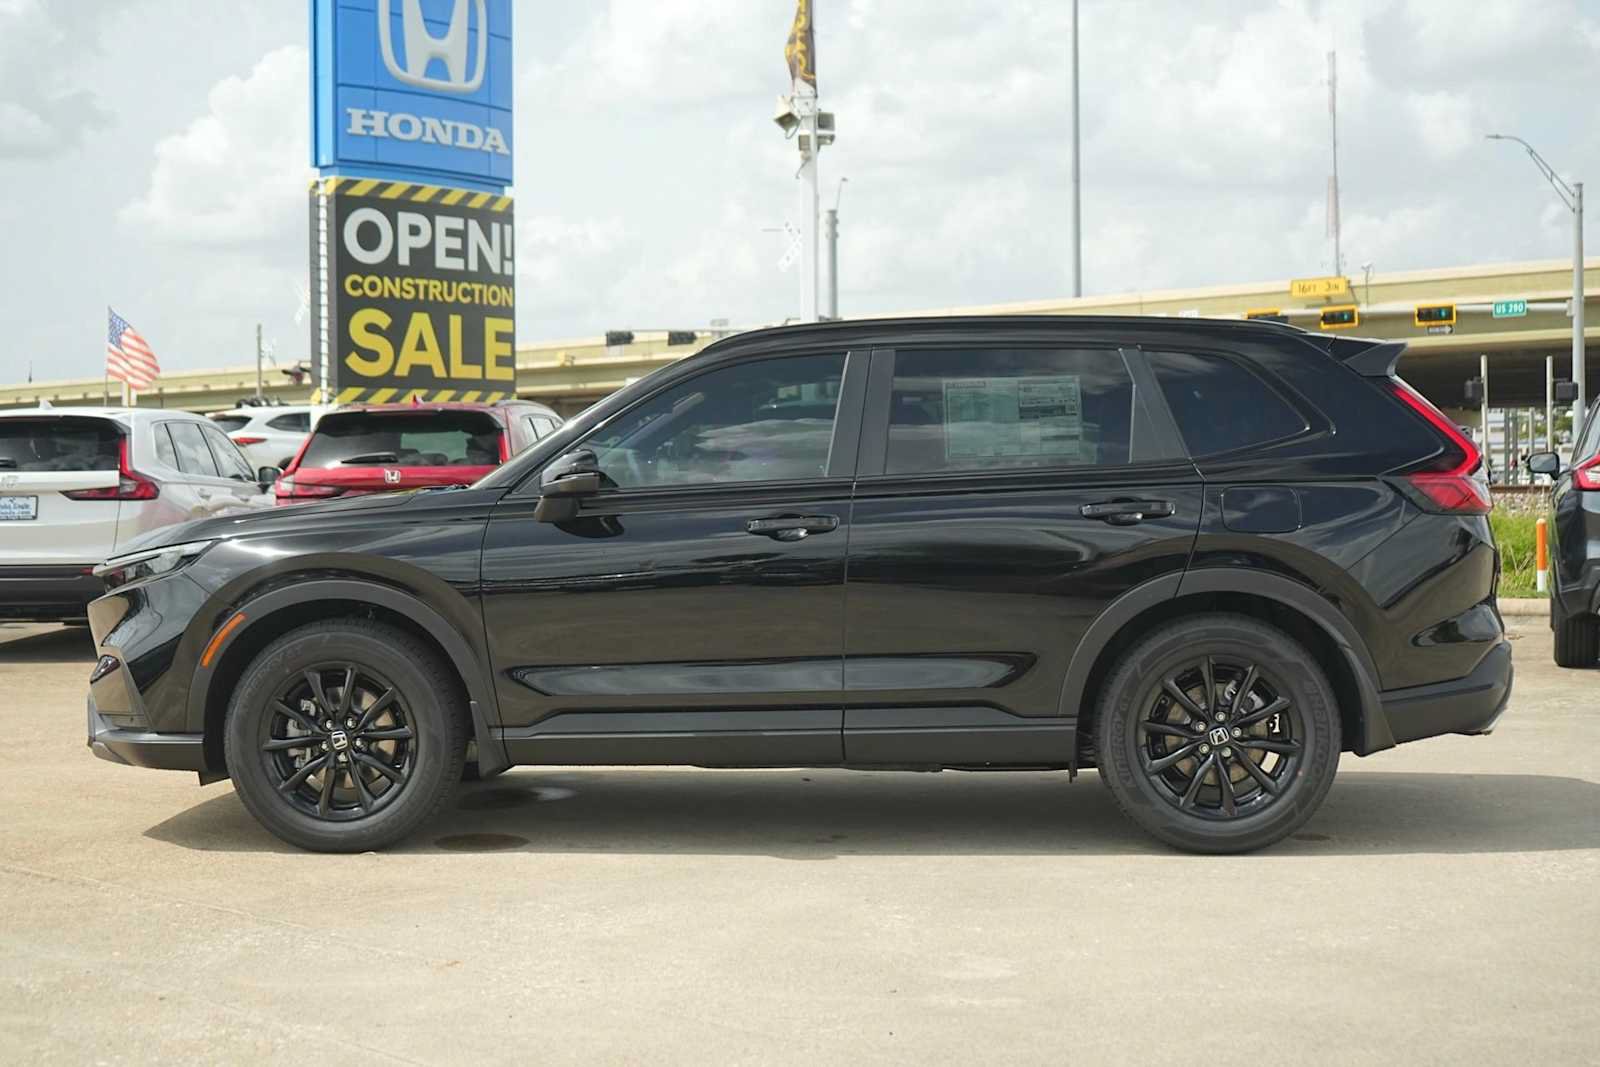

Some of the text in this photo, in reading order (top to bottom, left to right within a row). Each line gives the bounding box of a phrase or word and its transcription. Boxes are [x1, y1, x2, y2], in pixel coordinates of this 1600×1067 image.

[346, 107, 510, 155] HONDA
[343, 207, 513, 275] OPEN!
[344, 274, 513, 307] CONSTRUCTION
[1495, 303, 1506, 314] US
[344, 308, 514, 381] SALE
